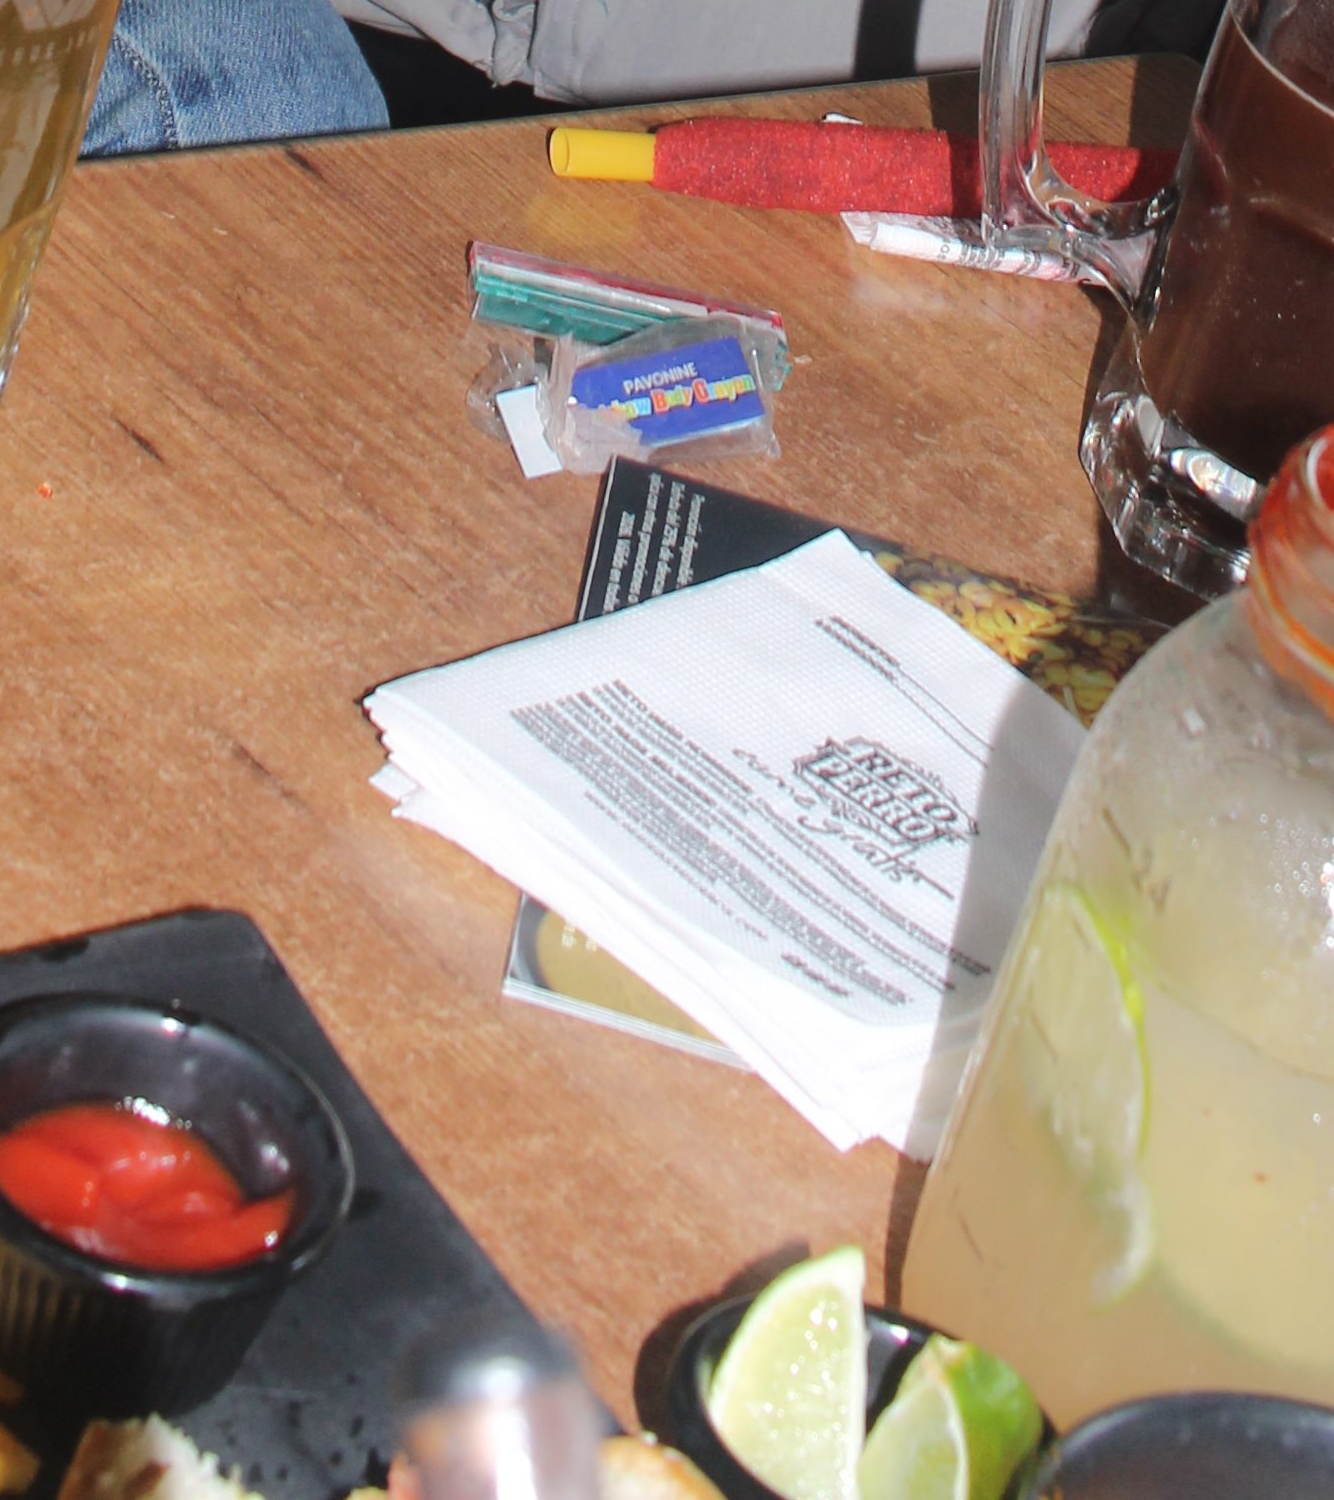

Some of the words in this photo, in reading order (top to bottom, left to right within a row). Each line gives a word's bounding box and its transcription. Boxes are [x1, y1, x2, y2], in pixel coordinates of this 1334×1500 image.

[622, 361, 699, 396] PAVONINE
[807, 753, 938, 842] PERRO
[853, 748, 958, 823] RETO
